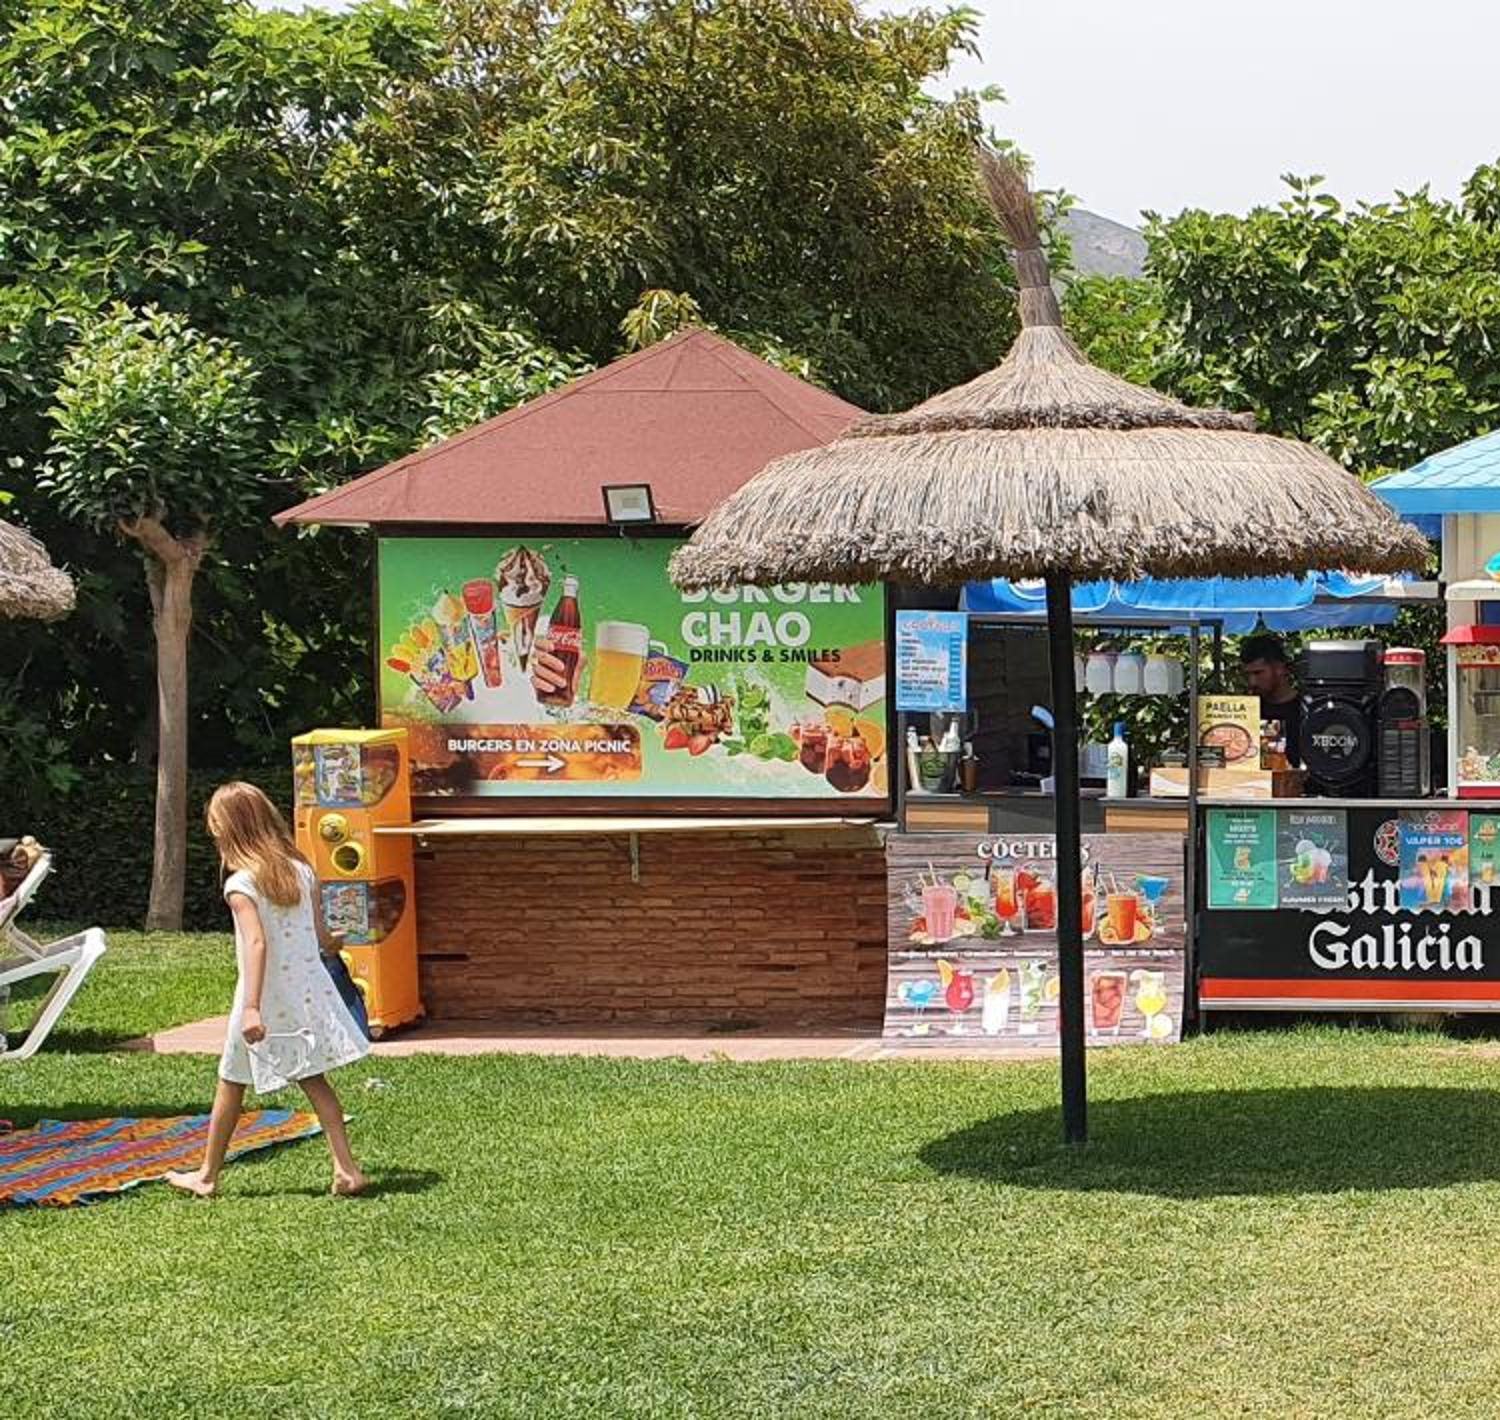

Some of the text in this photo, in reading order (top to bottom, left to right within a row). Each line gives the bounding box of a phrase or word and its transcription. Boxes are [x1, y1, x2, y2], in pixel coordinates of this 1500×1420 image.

[681, 583, 862, 603] GER
[681, 611, 812, 647] CHAO
[690, 649, 842, 662] DRINKS & SMILES
[1205, 702, 1247, 713] PAELLA
[448, 739, 631, 752] BURGERS EN ZONA PICNIC
[1405, 835, 1441, 845] VAPER
[976, 837, 1090, 860] CÓCTES
[1309, 920, 1485, 971] Galicia
